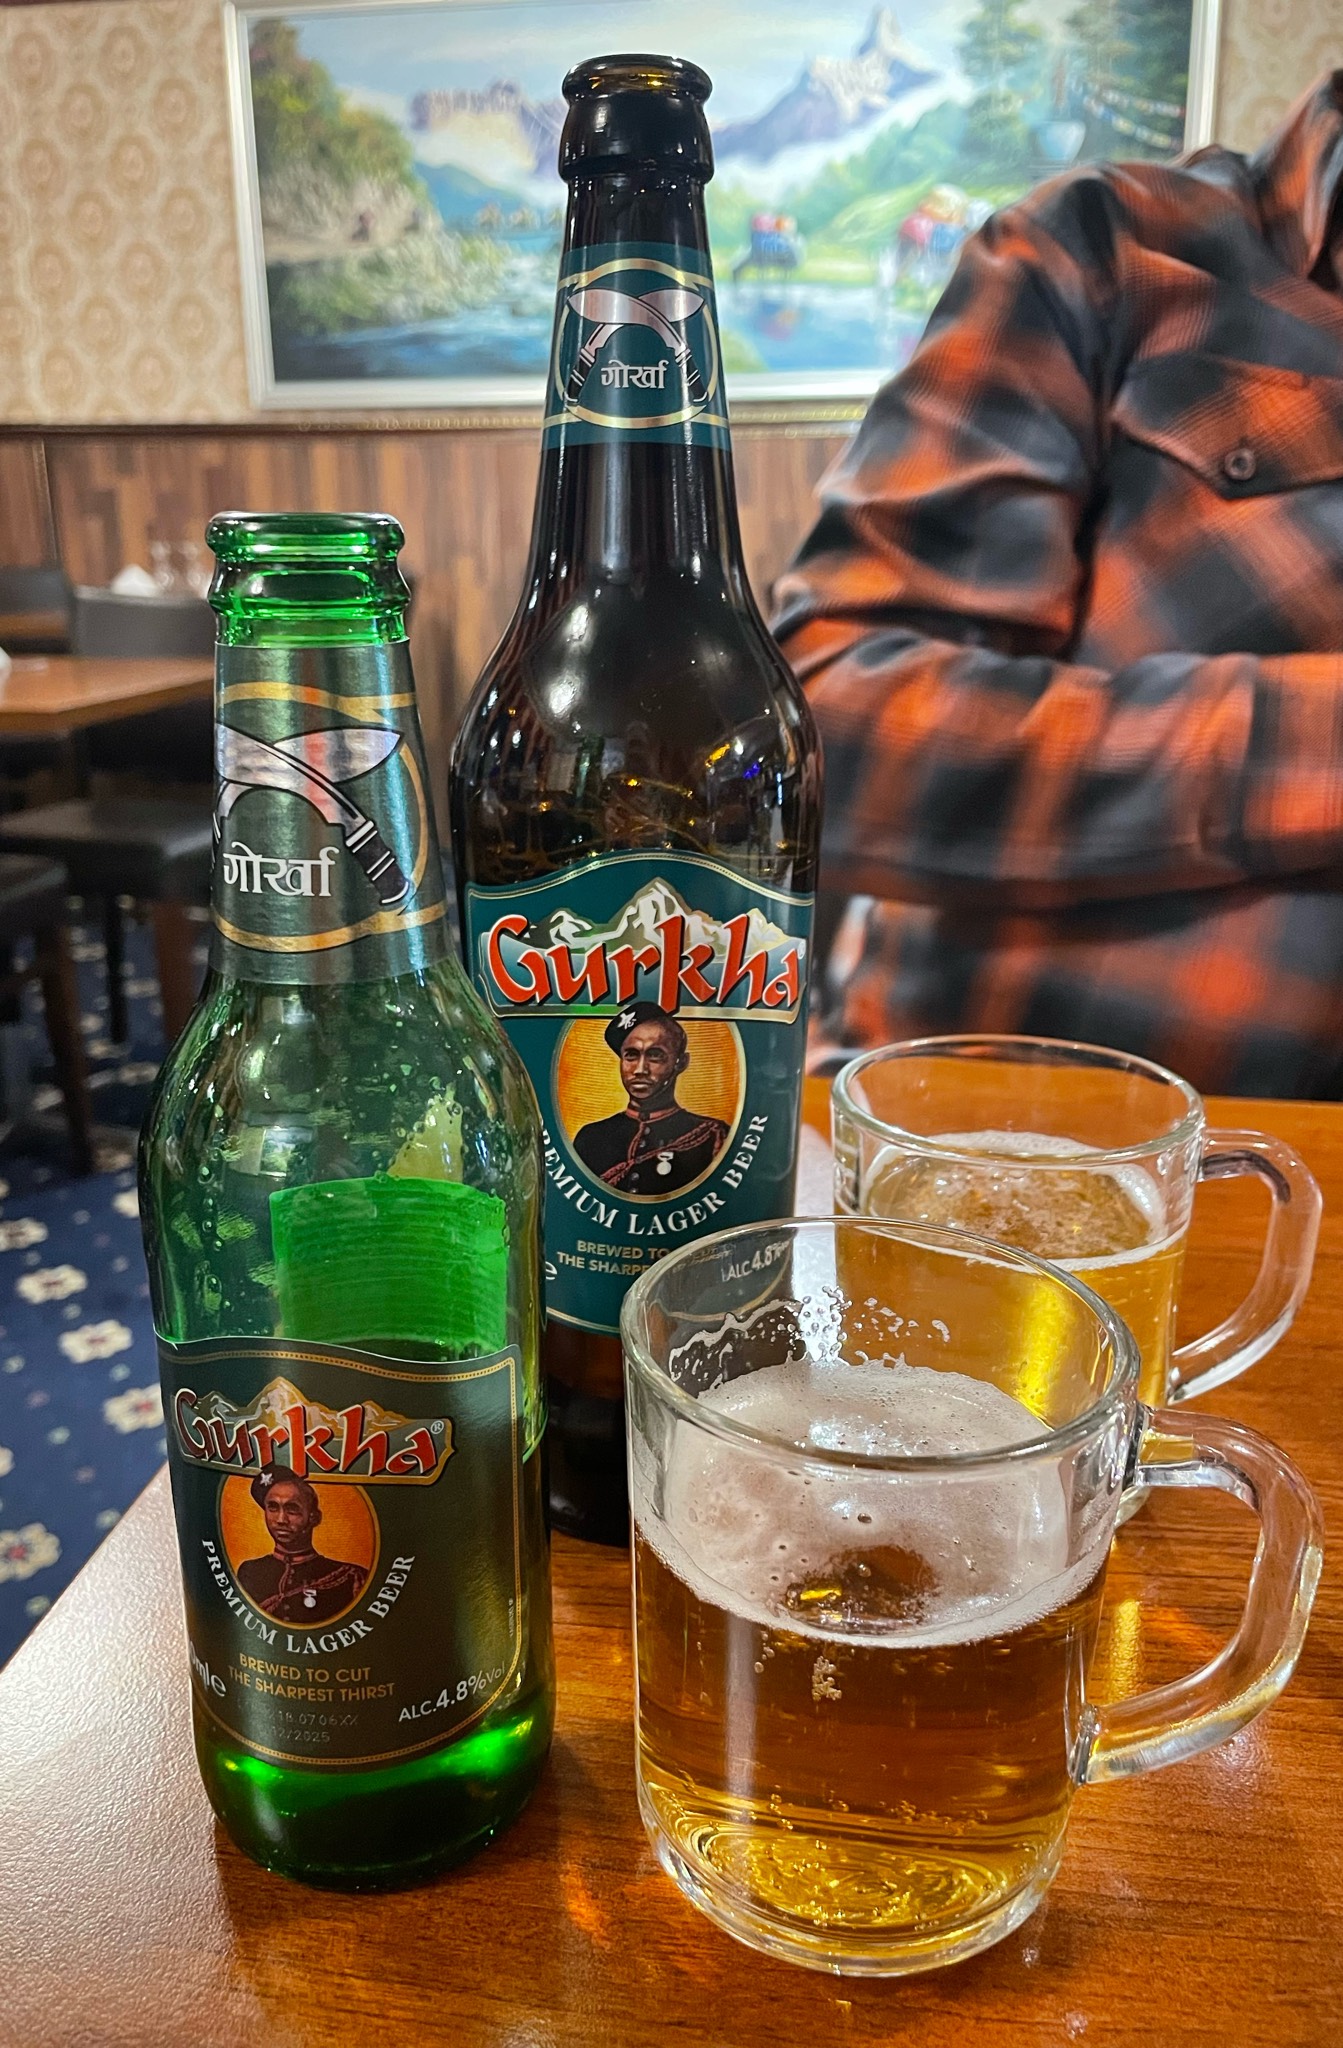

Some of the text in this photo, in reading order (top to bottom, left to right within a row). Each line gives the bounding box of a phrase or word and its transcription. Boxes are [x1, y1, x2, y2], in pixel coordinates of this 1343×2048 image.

[488, 913, 799, 1014] Gurkha
[541, 1114, 769, 1236] EMIUM LAGER BEER
[557, 1251, 585, 1269] THE
[576, 1239, 644, 1259] BREWED
[647, 1247, 671, 1260] TO
[175, 1387, 438, 1478] Gurkha
[201, 1539, 416, 1655] PREMIUM LAGER BEER
[227, 1664, 396, 1702] THE SHARPEST THIRST
[239, 1652, 372, 1684] BREWED TO CUT
